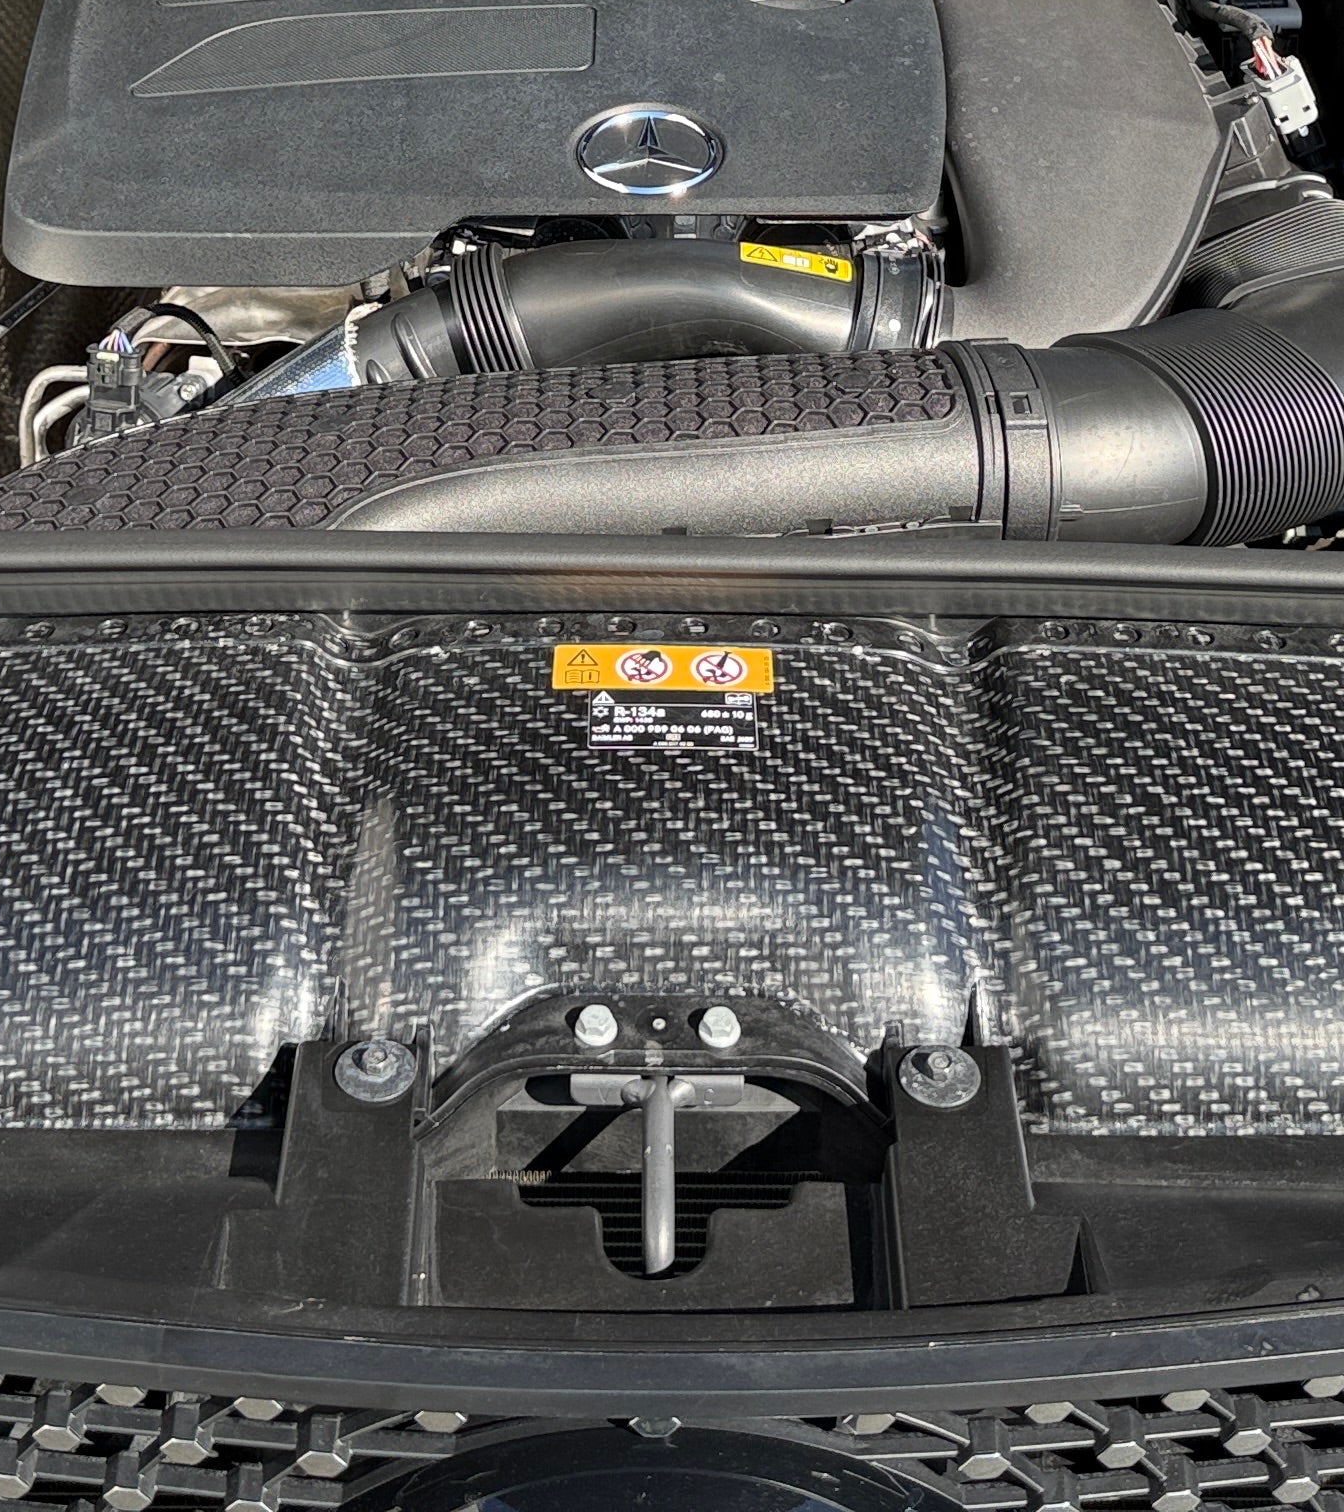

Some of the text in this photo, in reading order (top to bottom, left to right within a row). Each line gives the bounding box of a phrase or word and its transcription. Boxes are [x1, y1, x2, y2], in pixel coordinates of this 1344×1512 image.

[614, 706, 666, 717] R-134a
[732, 710, 744, 718] 10
[704, 725, 733, 735] (PAG)
